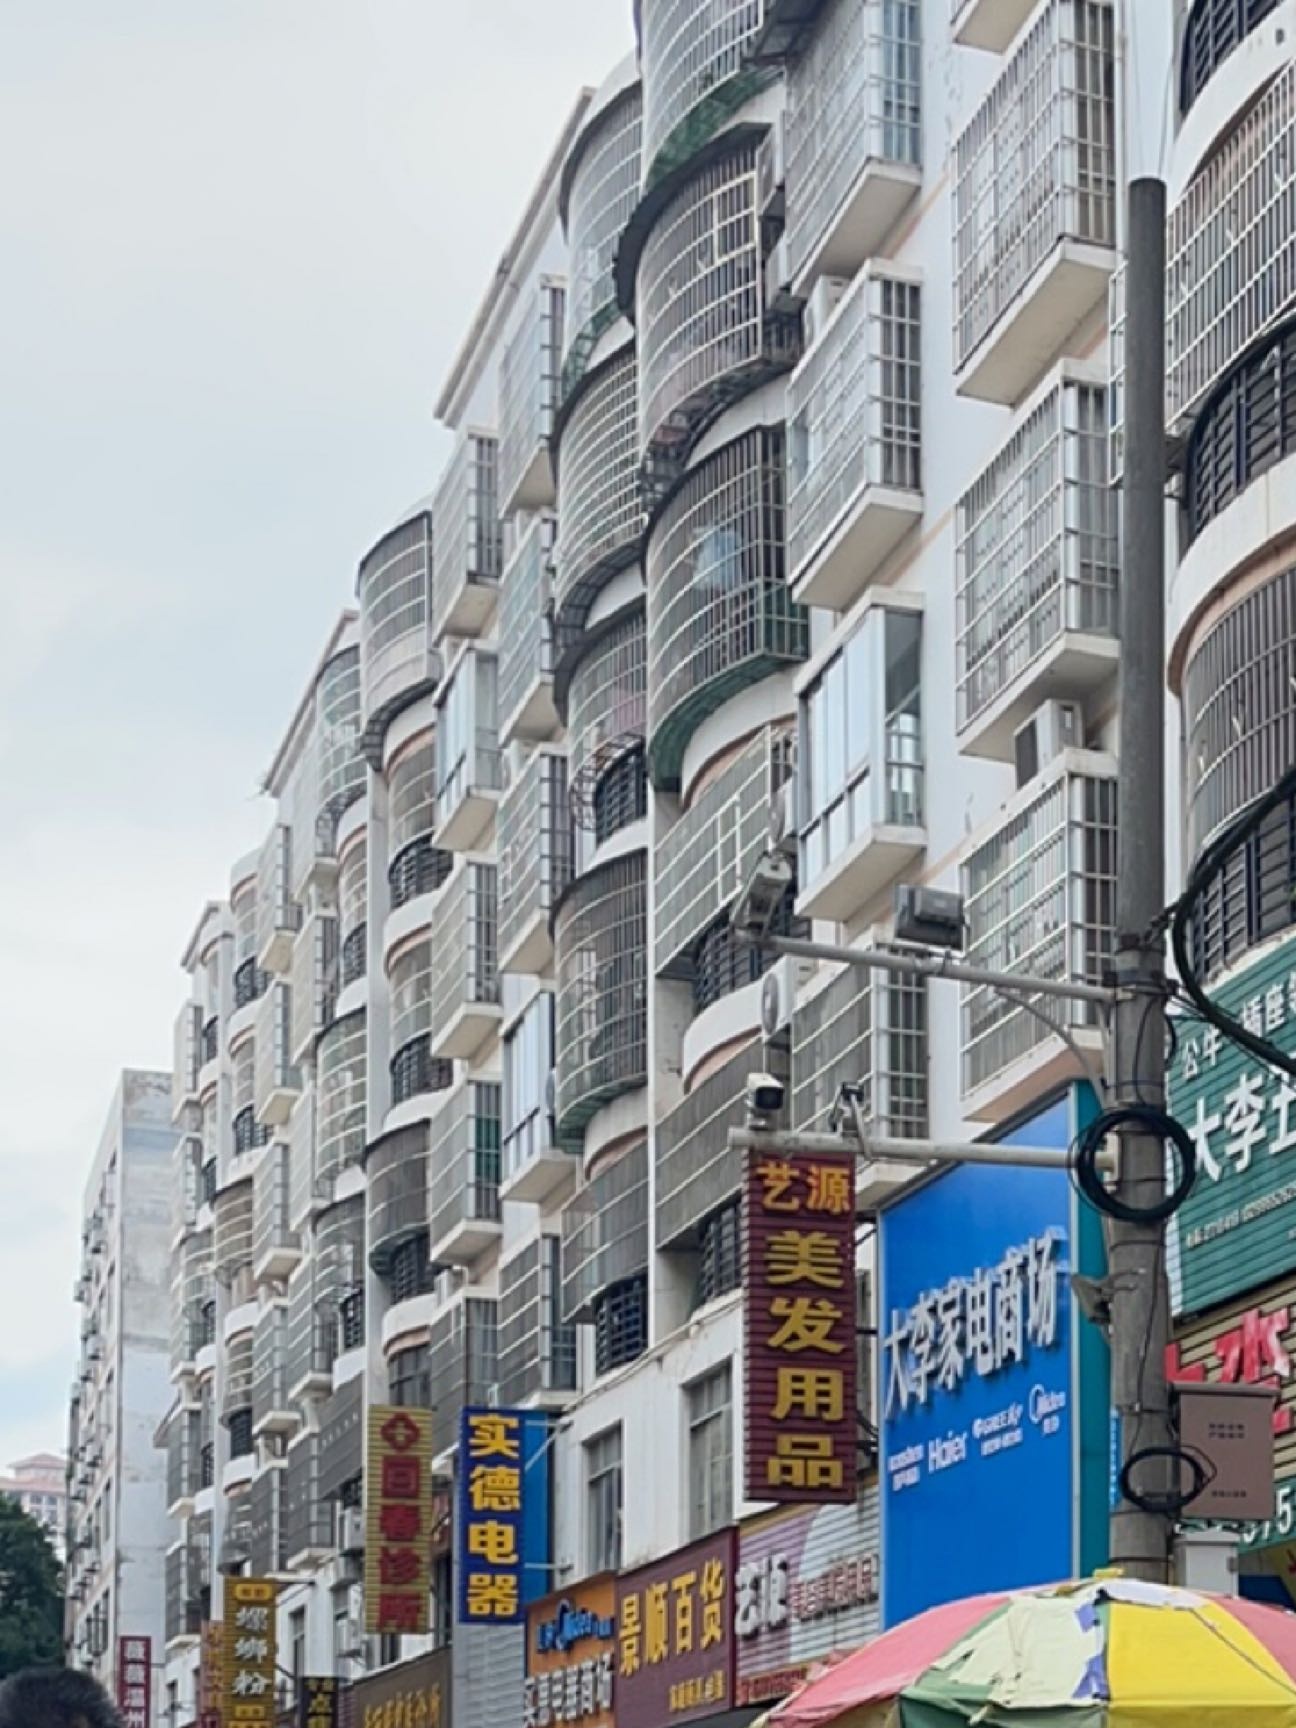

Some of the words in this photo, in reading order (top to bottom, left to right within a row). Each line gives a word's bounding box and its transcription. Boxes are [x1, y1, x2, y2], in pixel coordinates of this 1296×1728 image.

[756, 1156, 852, 1213] 艺源
[761, 1229, 845, 1491] 美发用品
[881, 1224, 1068, 1422] 大李家电商场
[467, 1413, 521, 1617] 实德电器
[928, 1429, 968, 1474] Haier
[619, 1557, 725, 1677] 景顺百货
